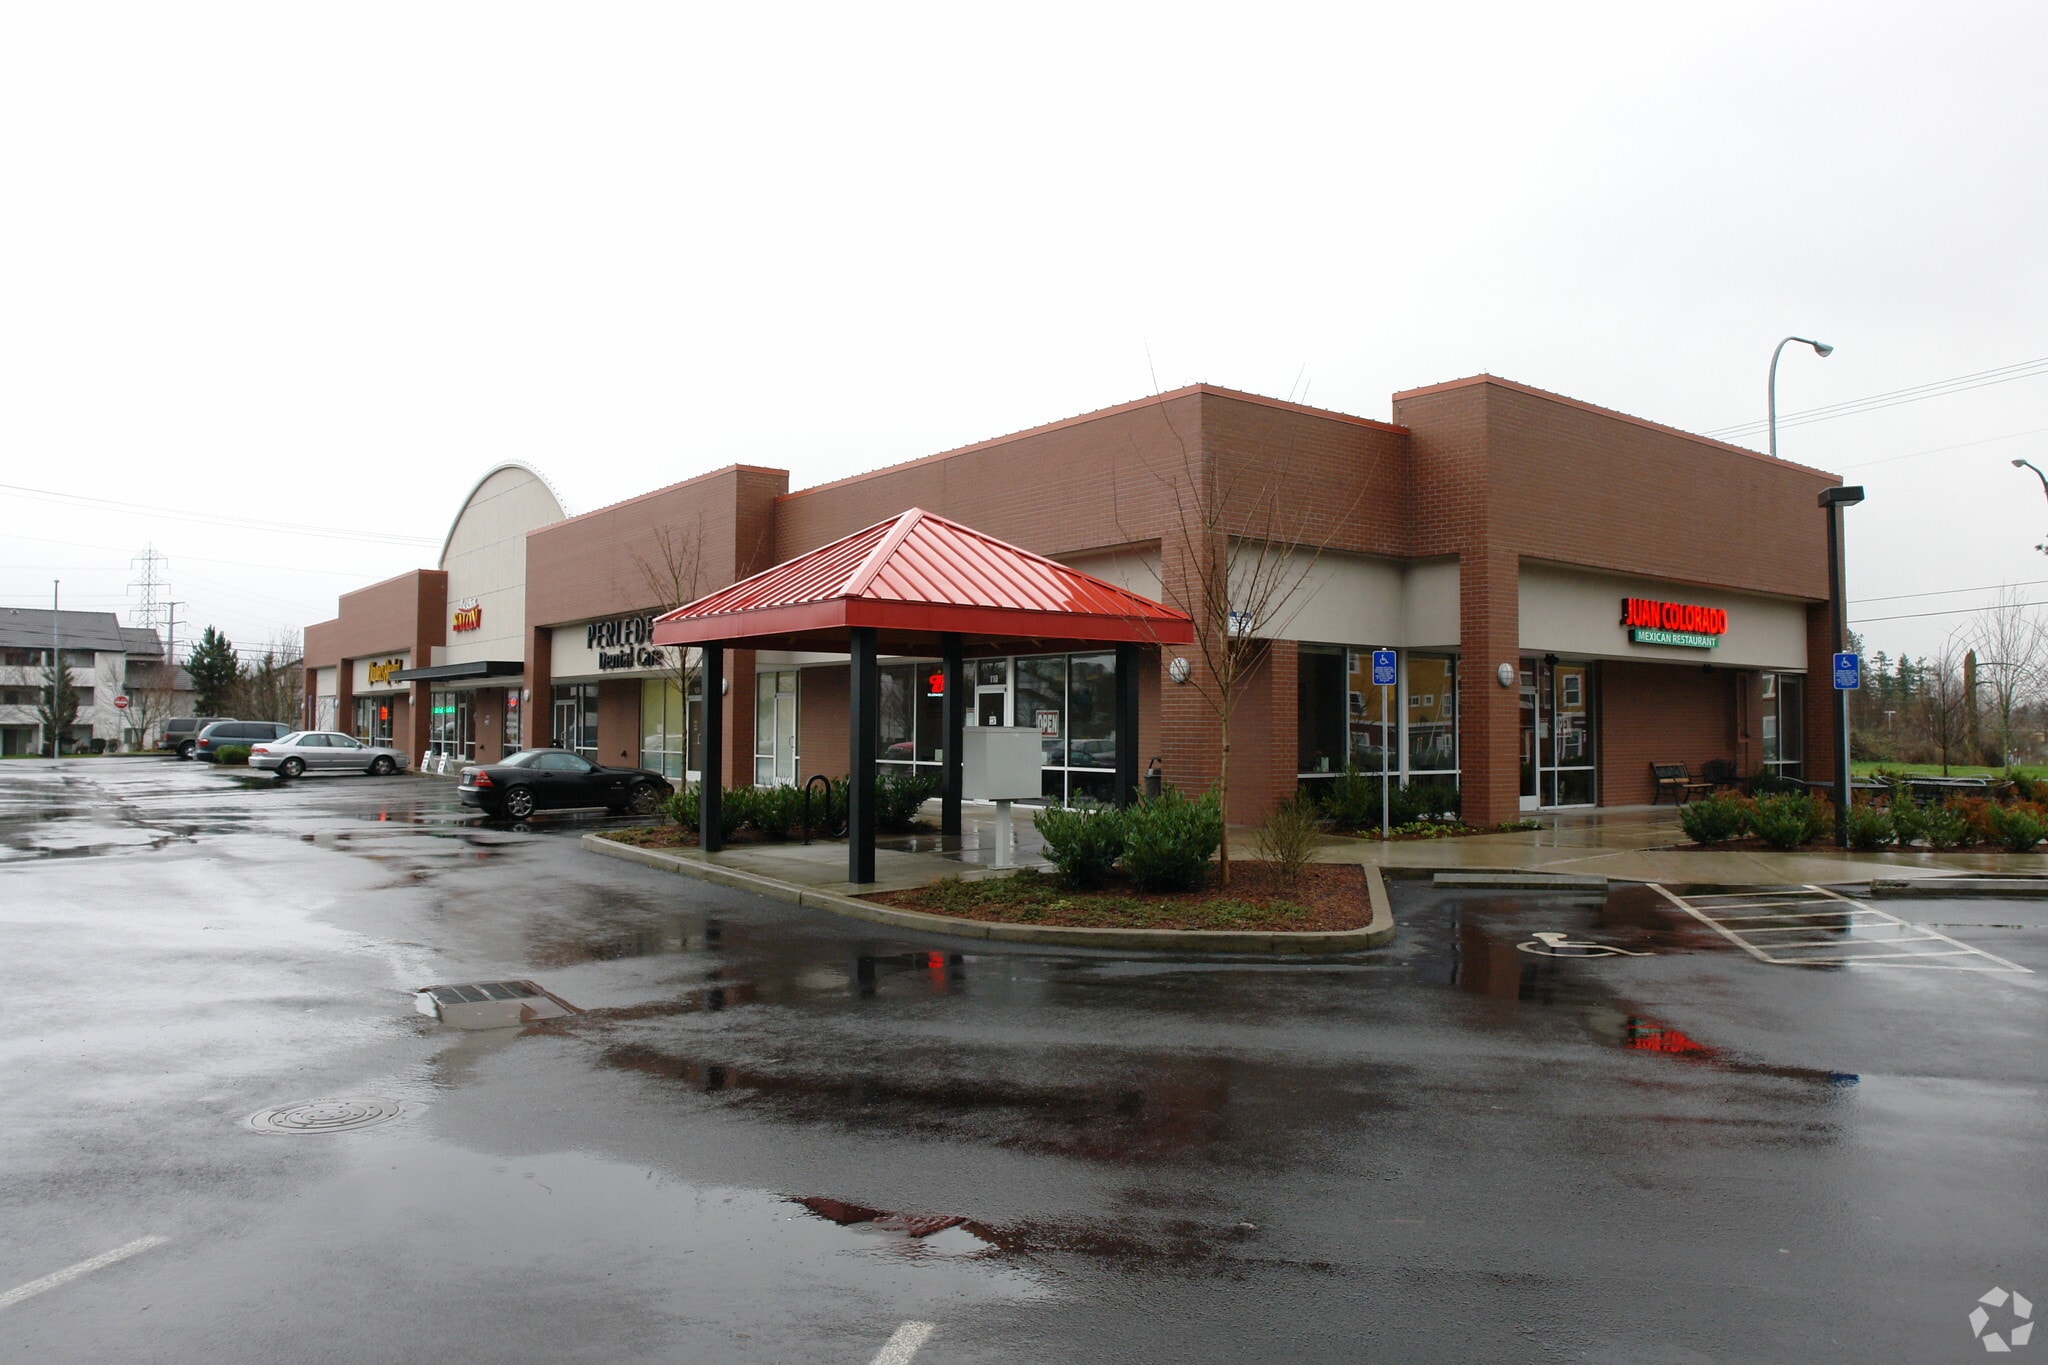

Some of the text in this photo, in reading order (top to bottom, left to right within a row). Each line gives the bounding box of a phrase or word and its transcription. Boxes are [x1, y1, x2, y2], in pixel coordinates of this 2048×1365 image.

[1625, 597, 1728, 635] JUAN COLORADO
[1638, 631, 1716, 647] MEXICAN RESTAURANT
[599, 646, 665, 670] Dental Care
[1038, 714, 1057, 733] OPEN
